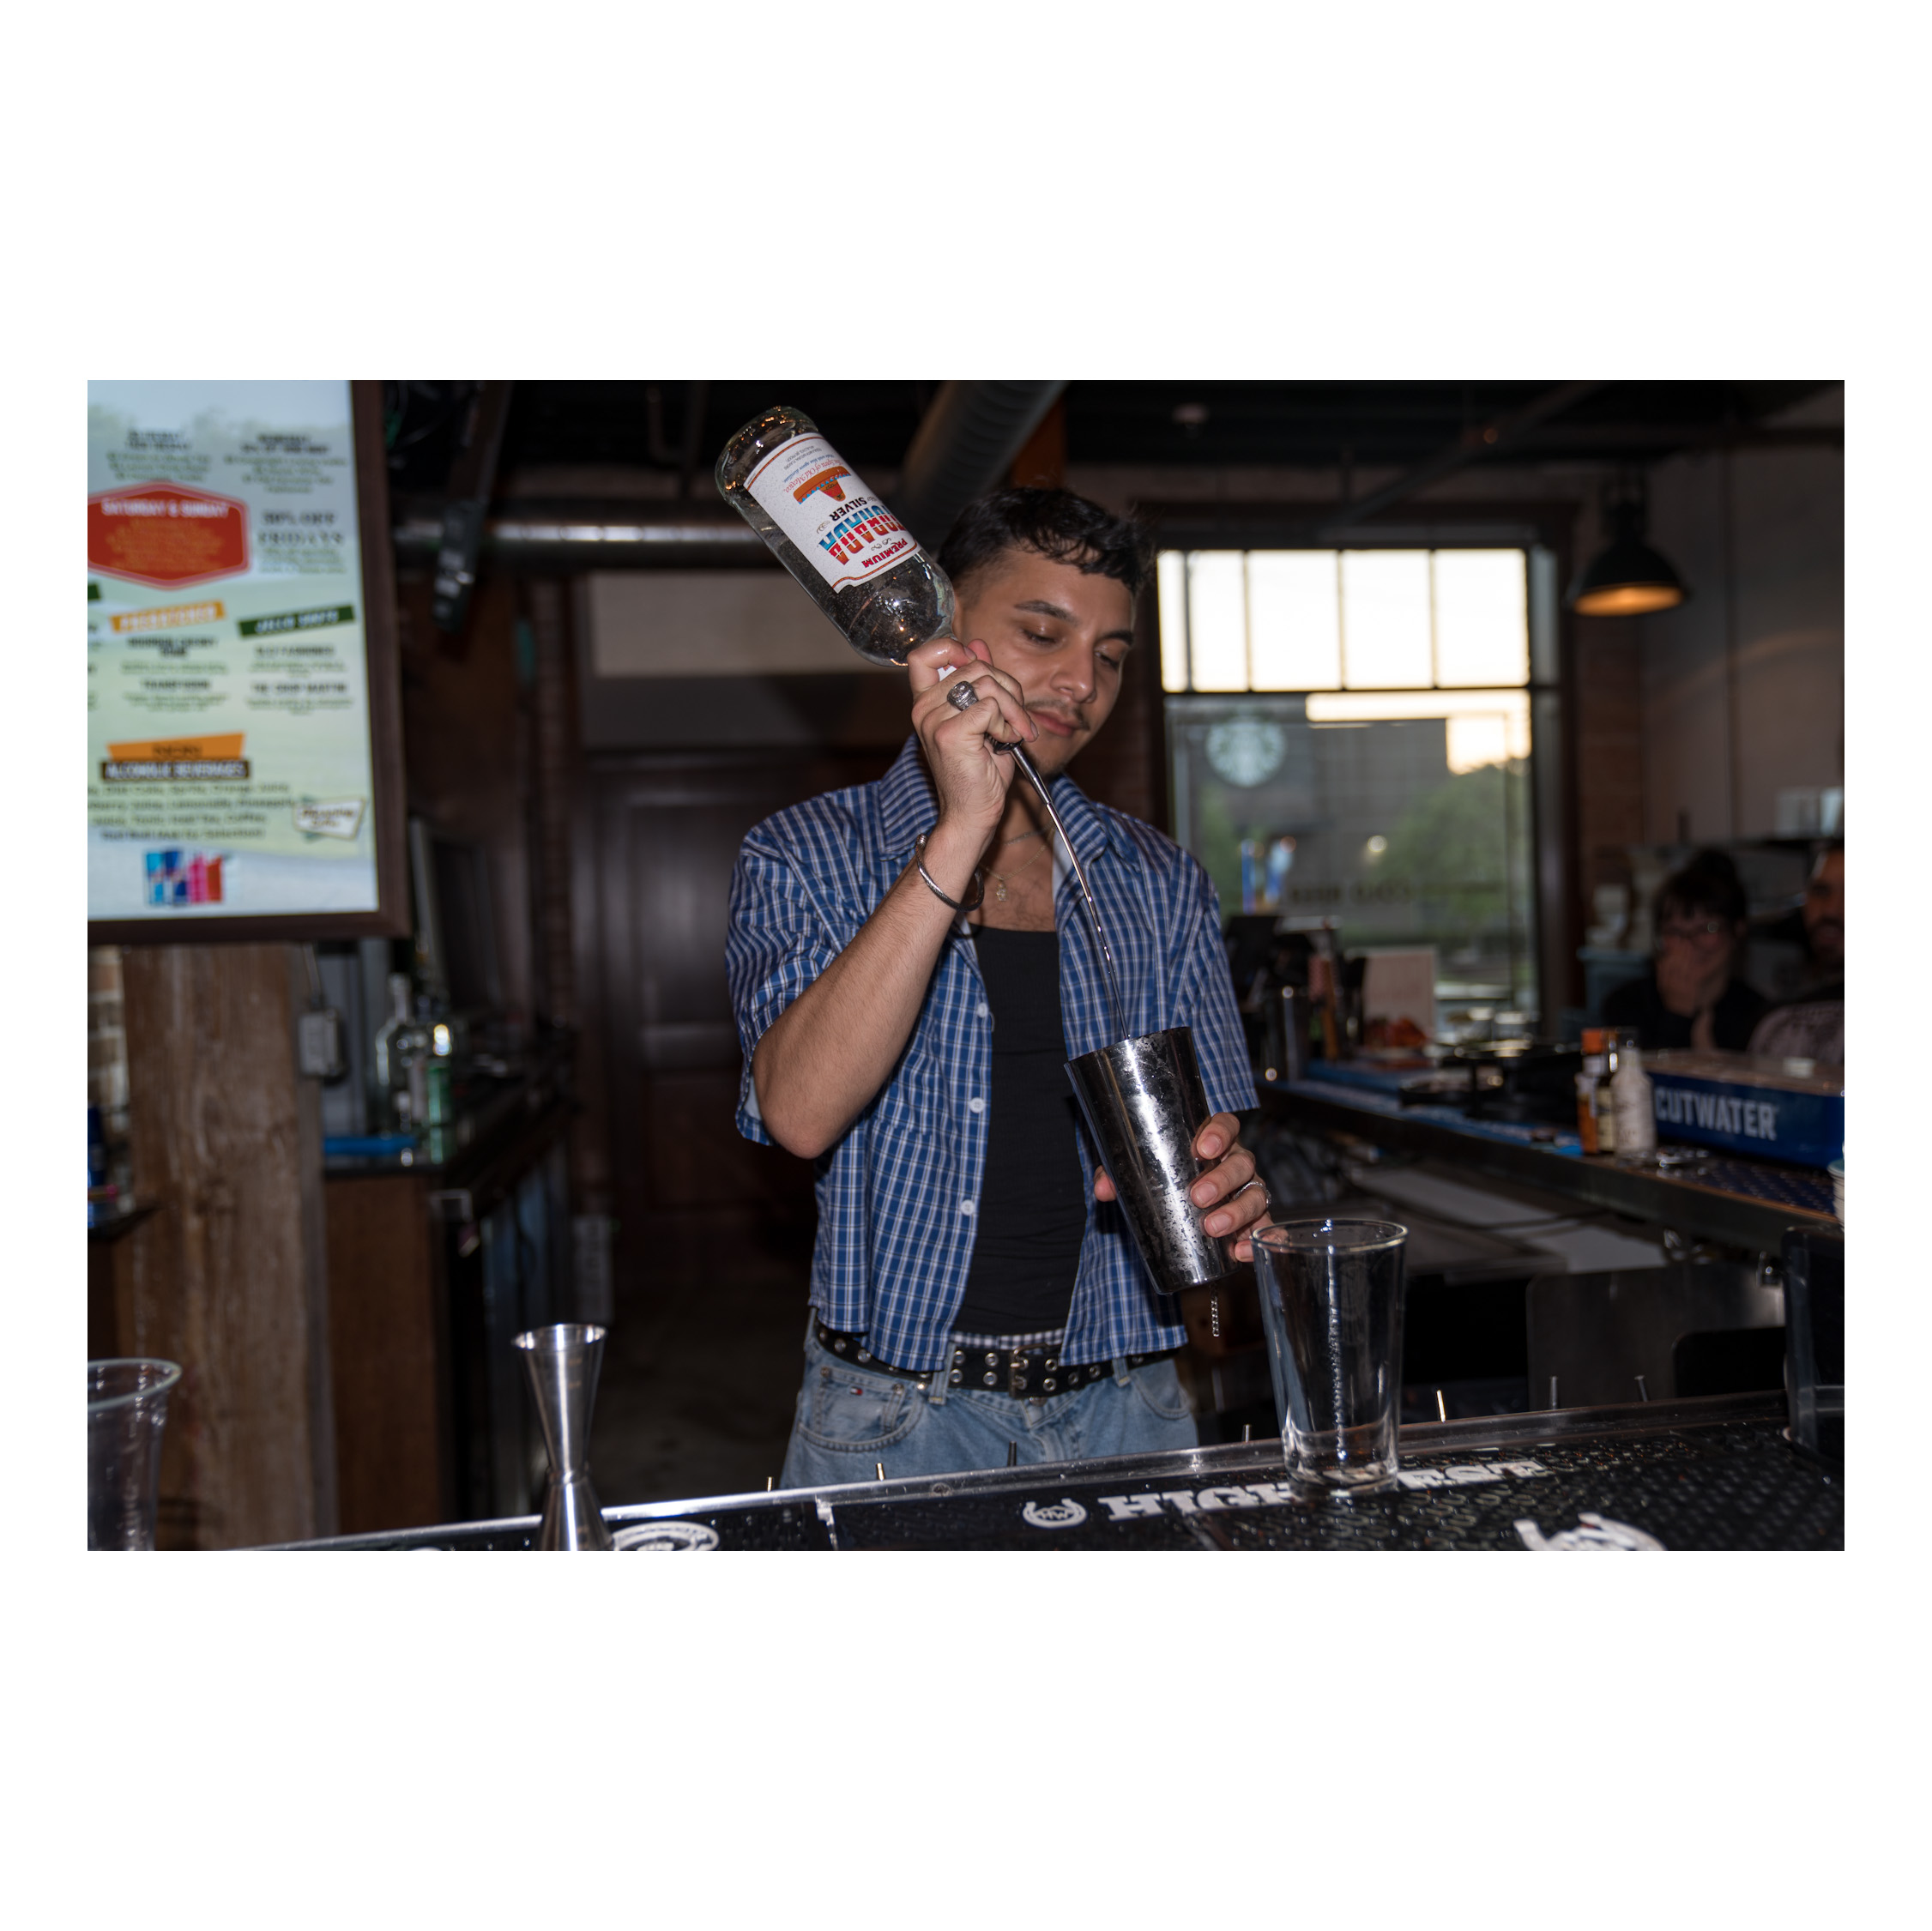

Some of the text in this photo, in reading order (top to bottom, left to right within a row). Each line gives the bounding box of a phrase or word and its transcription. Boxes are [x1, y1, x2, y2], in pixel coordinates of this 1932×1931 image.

[803, 467, 817, 479] Old
[819, 458, 836, 468] Spirit
[829, 497, 867, 522] SILVER
[861, 538, 909, 568] PREMIUM
[1655, 1086, 1777, 1141] CUTWATER
